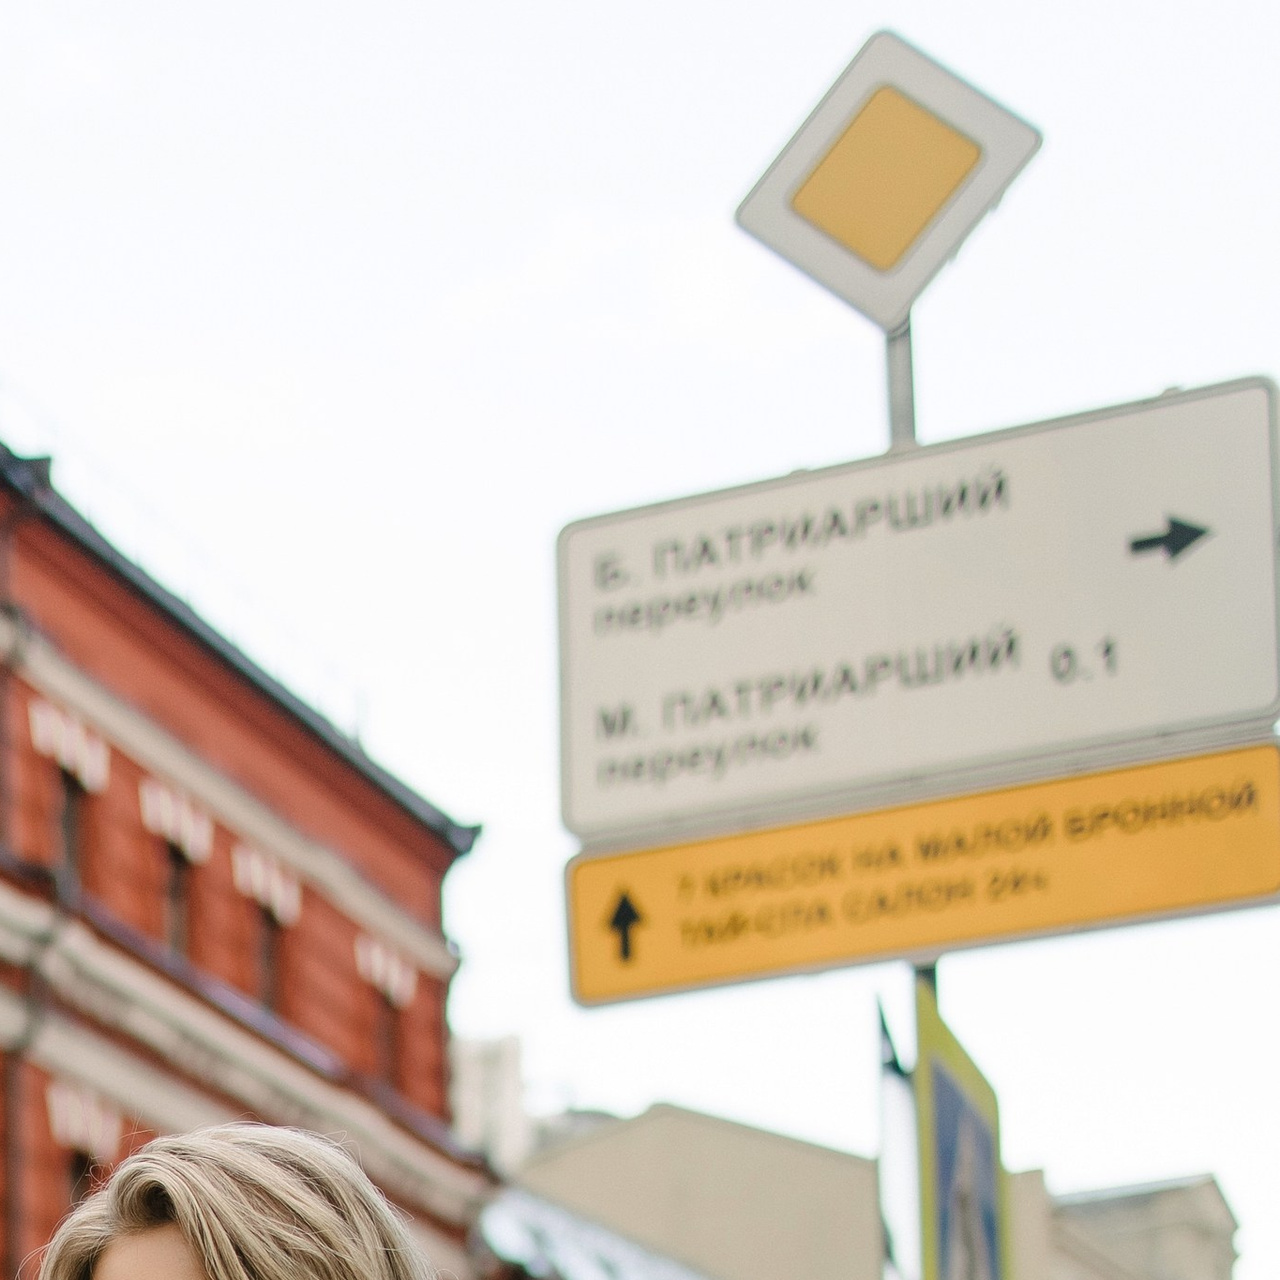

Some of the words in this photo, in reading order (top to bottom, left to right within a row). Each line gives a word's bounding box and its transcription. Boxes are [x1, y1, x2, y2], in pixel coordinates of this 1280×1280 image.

[651, 466, 1011, 580] ПАТРИАРШИЙ
[592, 566, 816, 636] переулок
[661, 620, 1020, 732] ПАТРИАРШИЙ
[596, 723, 817, 791] переулок
[851, 843, 902, 874] НА
[914, 814, 1052, 864] МАЛОЙ
[1062, 778, 1260, 842] БРОННОЙ
[842, 874, 978, 924] САЛОН
